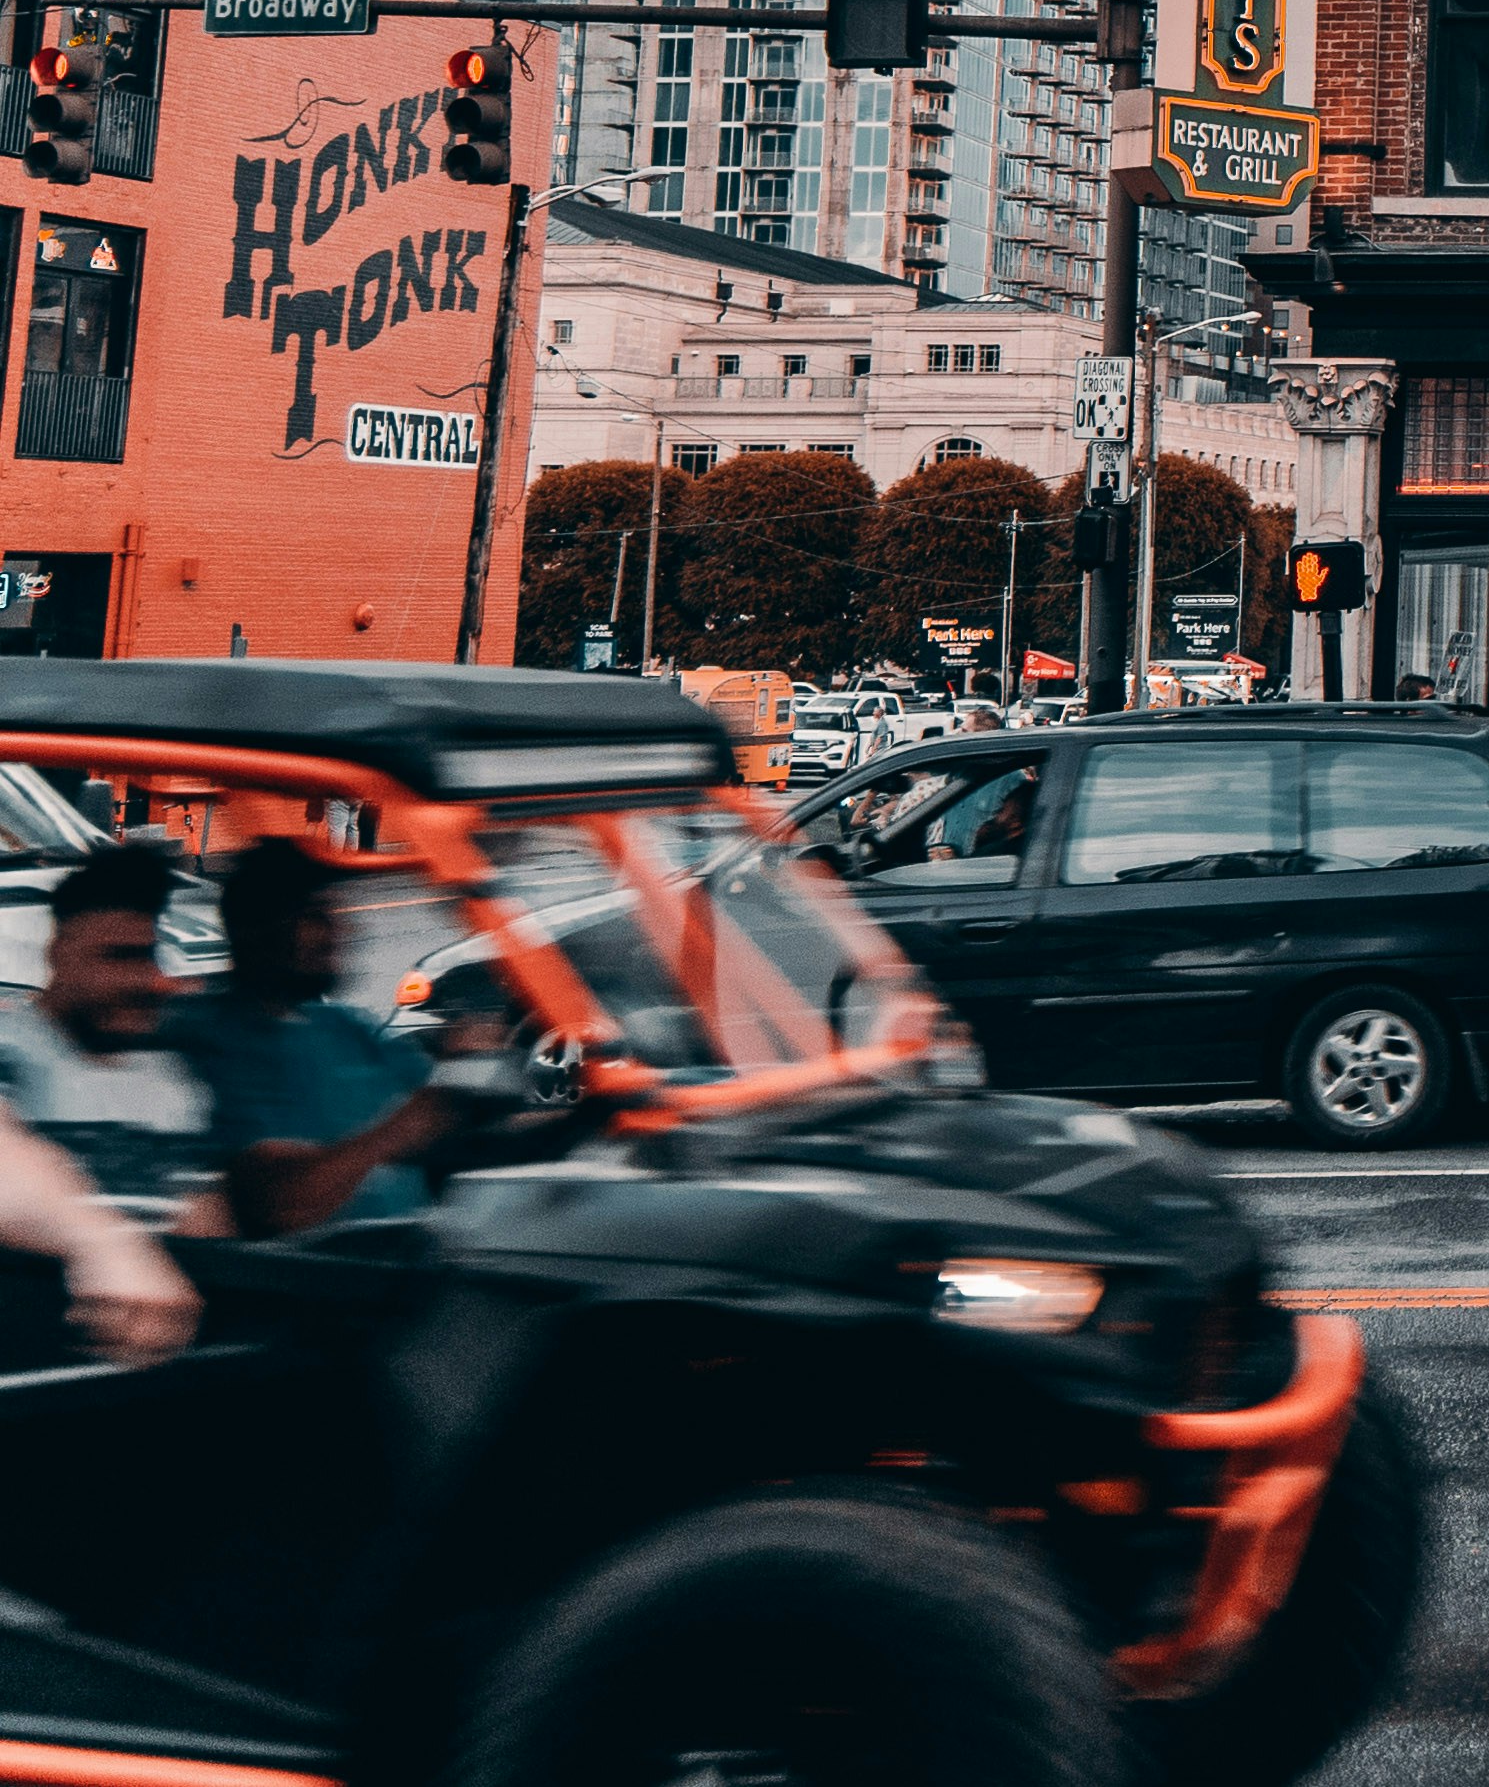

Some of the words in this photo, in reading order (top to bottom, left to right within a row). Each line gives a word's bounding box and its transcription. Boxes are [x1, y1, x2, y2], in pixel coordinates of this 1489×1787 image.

[1173, 119, 1302, 158] RESTAURANT
[1192, 149, 1208, 177] &
[1225, 154, 1282, 185] GRILL
[223, 87, 460, 319] HONK
[271, 229, 486, 450] TONK
[1083, 361, 1126, 376] DIAGONAL
[1082, 378, 1125, 393] CROSSING
[1076, 398, 1097, 428] OK
[351, 408, 479, 464] CENTRAL
[1096, 443, 1125, 453] CROSS
[1098, 452, 1122, 462] ONLY
[1103, 461, 1117, 471] ON
[928, 627, 959, 642] Park
[960, 627, 995, 641] Here
[1176, 622, 1201, 634] Park
[1203, 623, 1231, 634] Here
